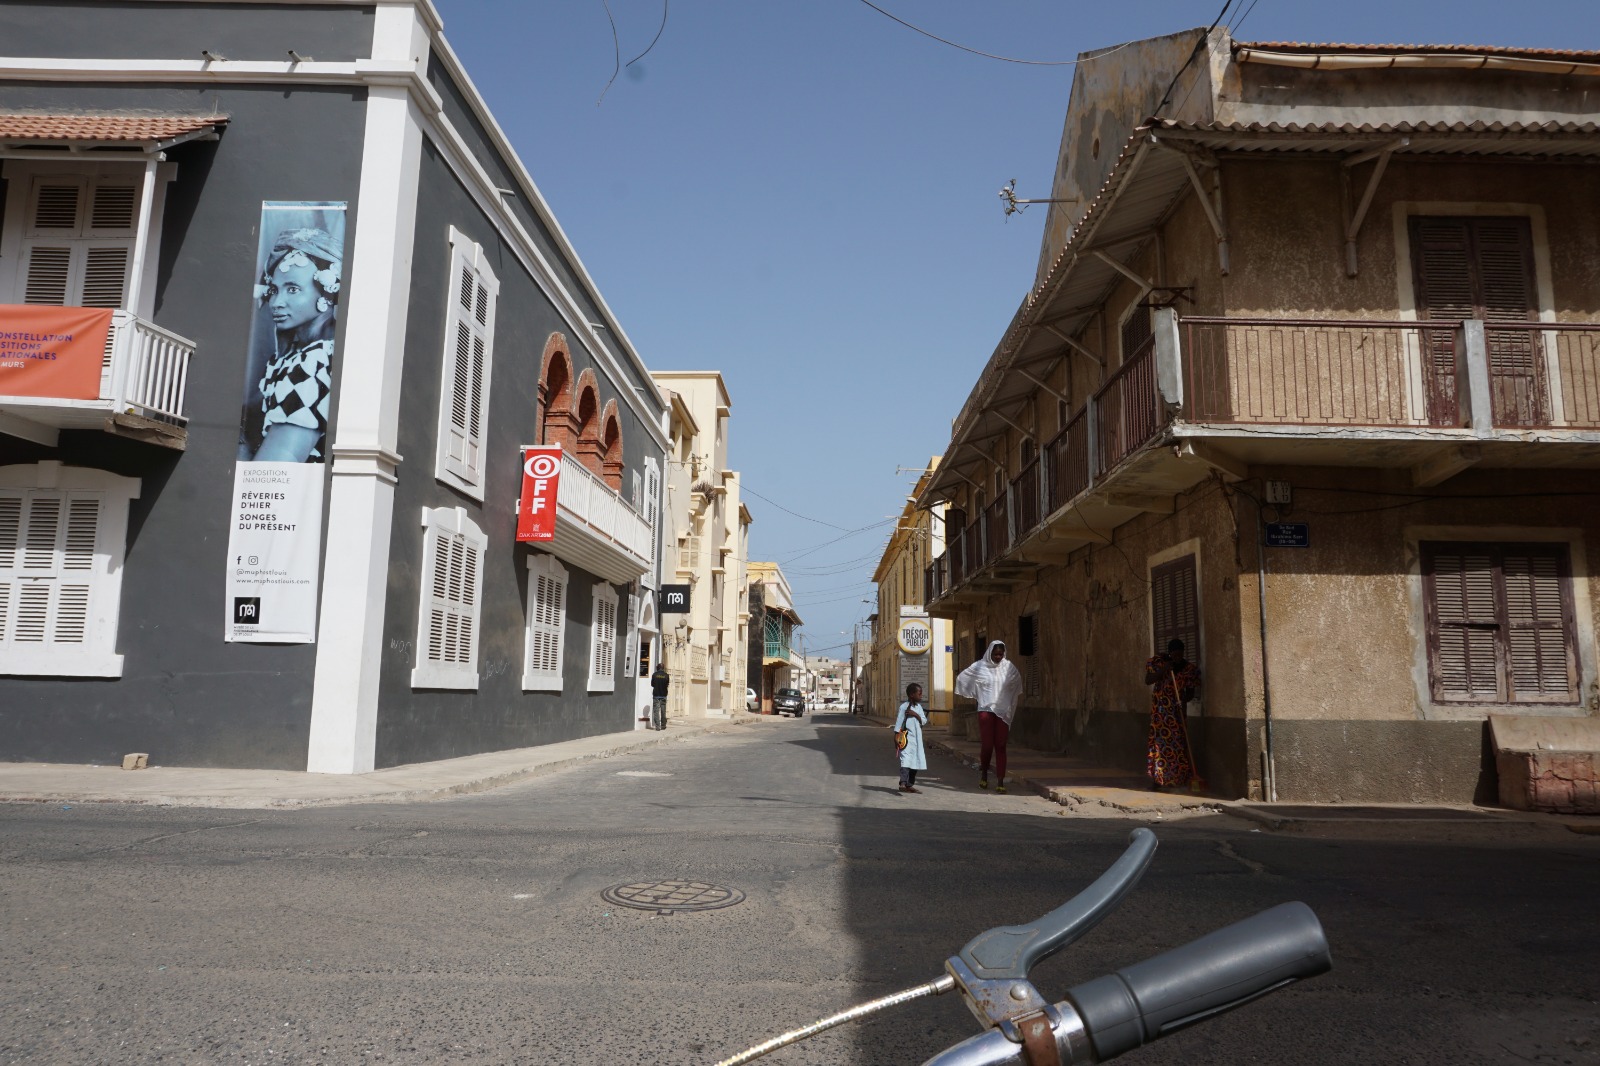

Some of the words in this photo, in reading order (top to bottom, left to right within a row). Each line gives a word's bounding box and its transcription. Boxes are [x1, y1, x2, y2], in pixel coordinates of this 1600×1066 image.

[1, 361, 25, 369] MURS
[243, 469, 288, 477] EXPOSITION
[241, 491, 285, 500] RÊVERIES
[239, 513, 277, 521] SONGES
[254, 522, 297, 532] PRÉSENT
[902, 626, 929, 640] TRÉSOR
[906, 639, 926, 647] PUBLIC
